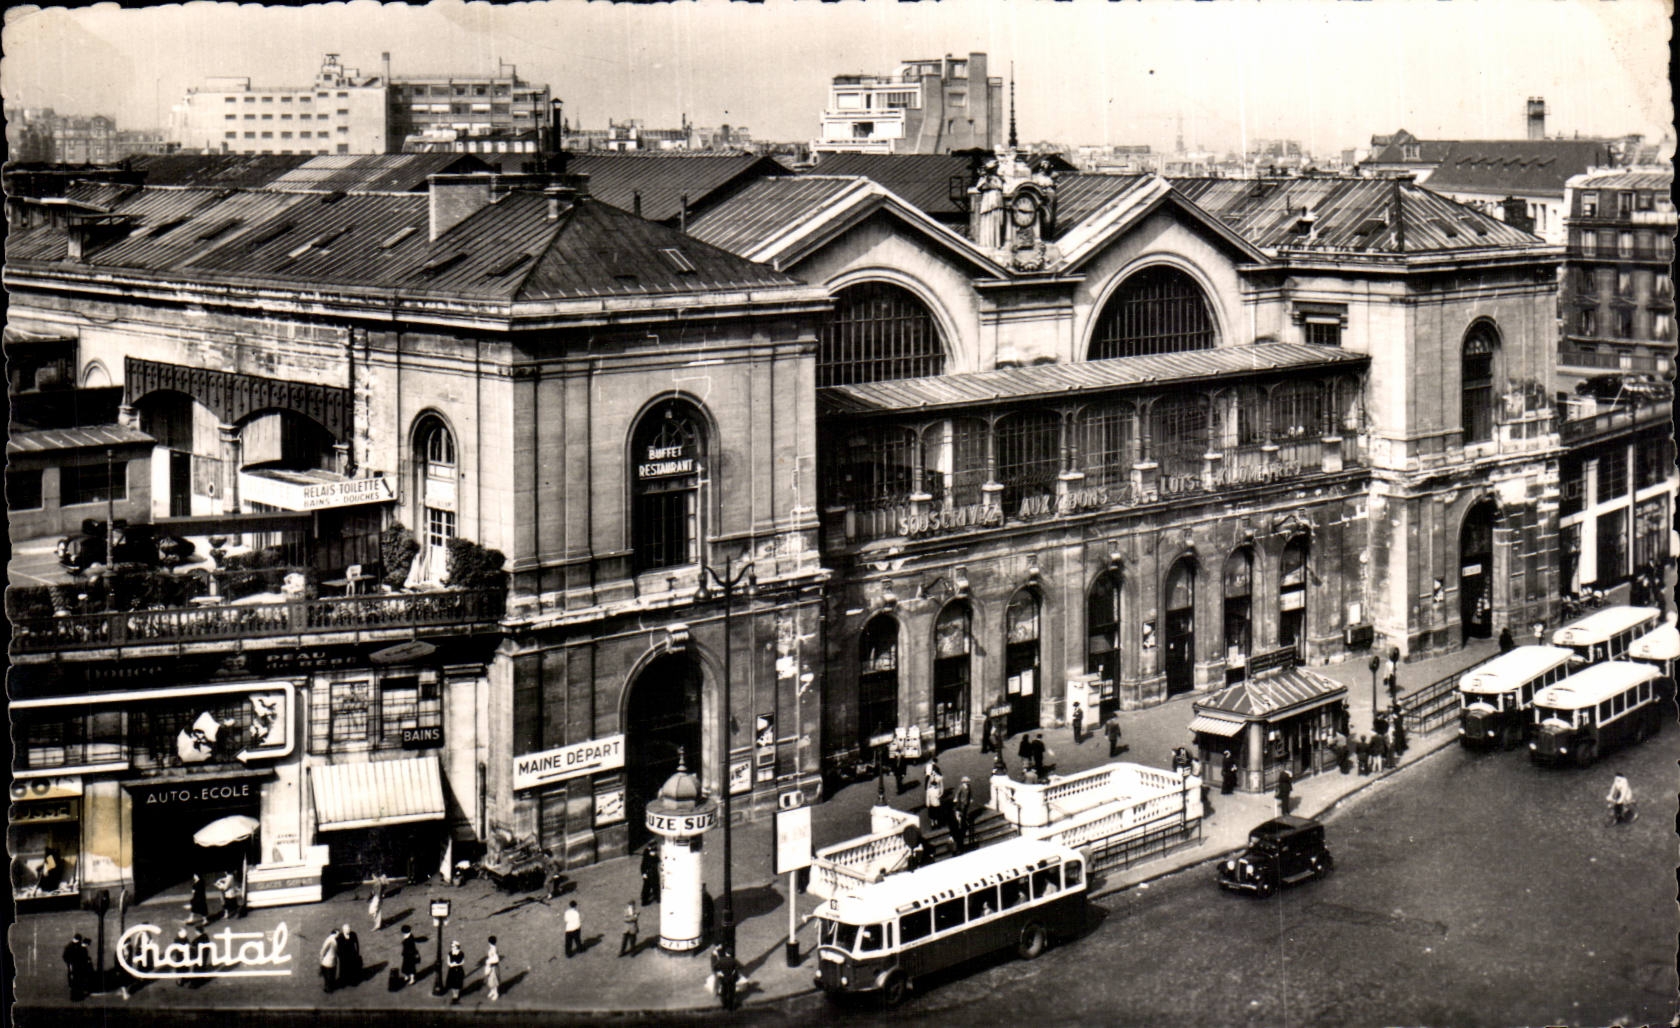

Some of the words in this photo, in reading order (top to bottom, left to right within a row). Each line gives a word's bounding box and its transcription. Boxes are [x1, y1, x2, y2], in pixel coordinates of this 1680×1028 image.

[648, 446, 682, 460] BUFFET
[639, 459, 693, 477] RESTAURANT
[303, 484, 336, 499] RELAIS
[340, 479, 380, 494] TOILETTE
[303, 497, 331, 508] BAINS
[343, 492, 380, 504] DOUCHES
[1020, 493, 1050, 516] AUX
[403, 728, 441, 742] BAINS
[519, 754, 561, 776] MAINE
[567, 741, 620, 765] DÉPART
[648, 814, 677, 831] UZE
[684, 813, 714, 831] SUZ
